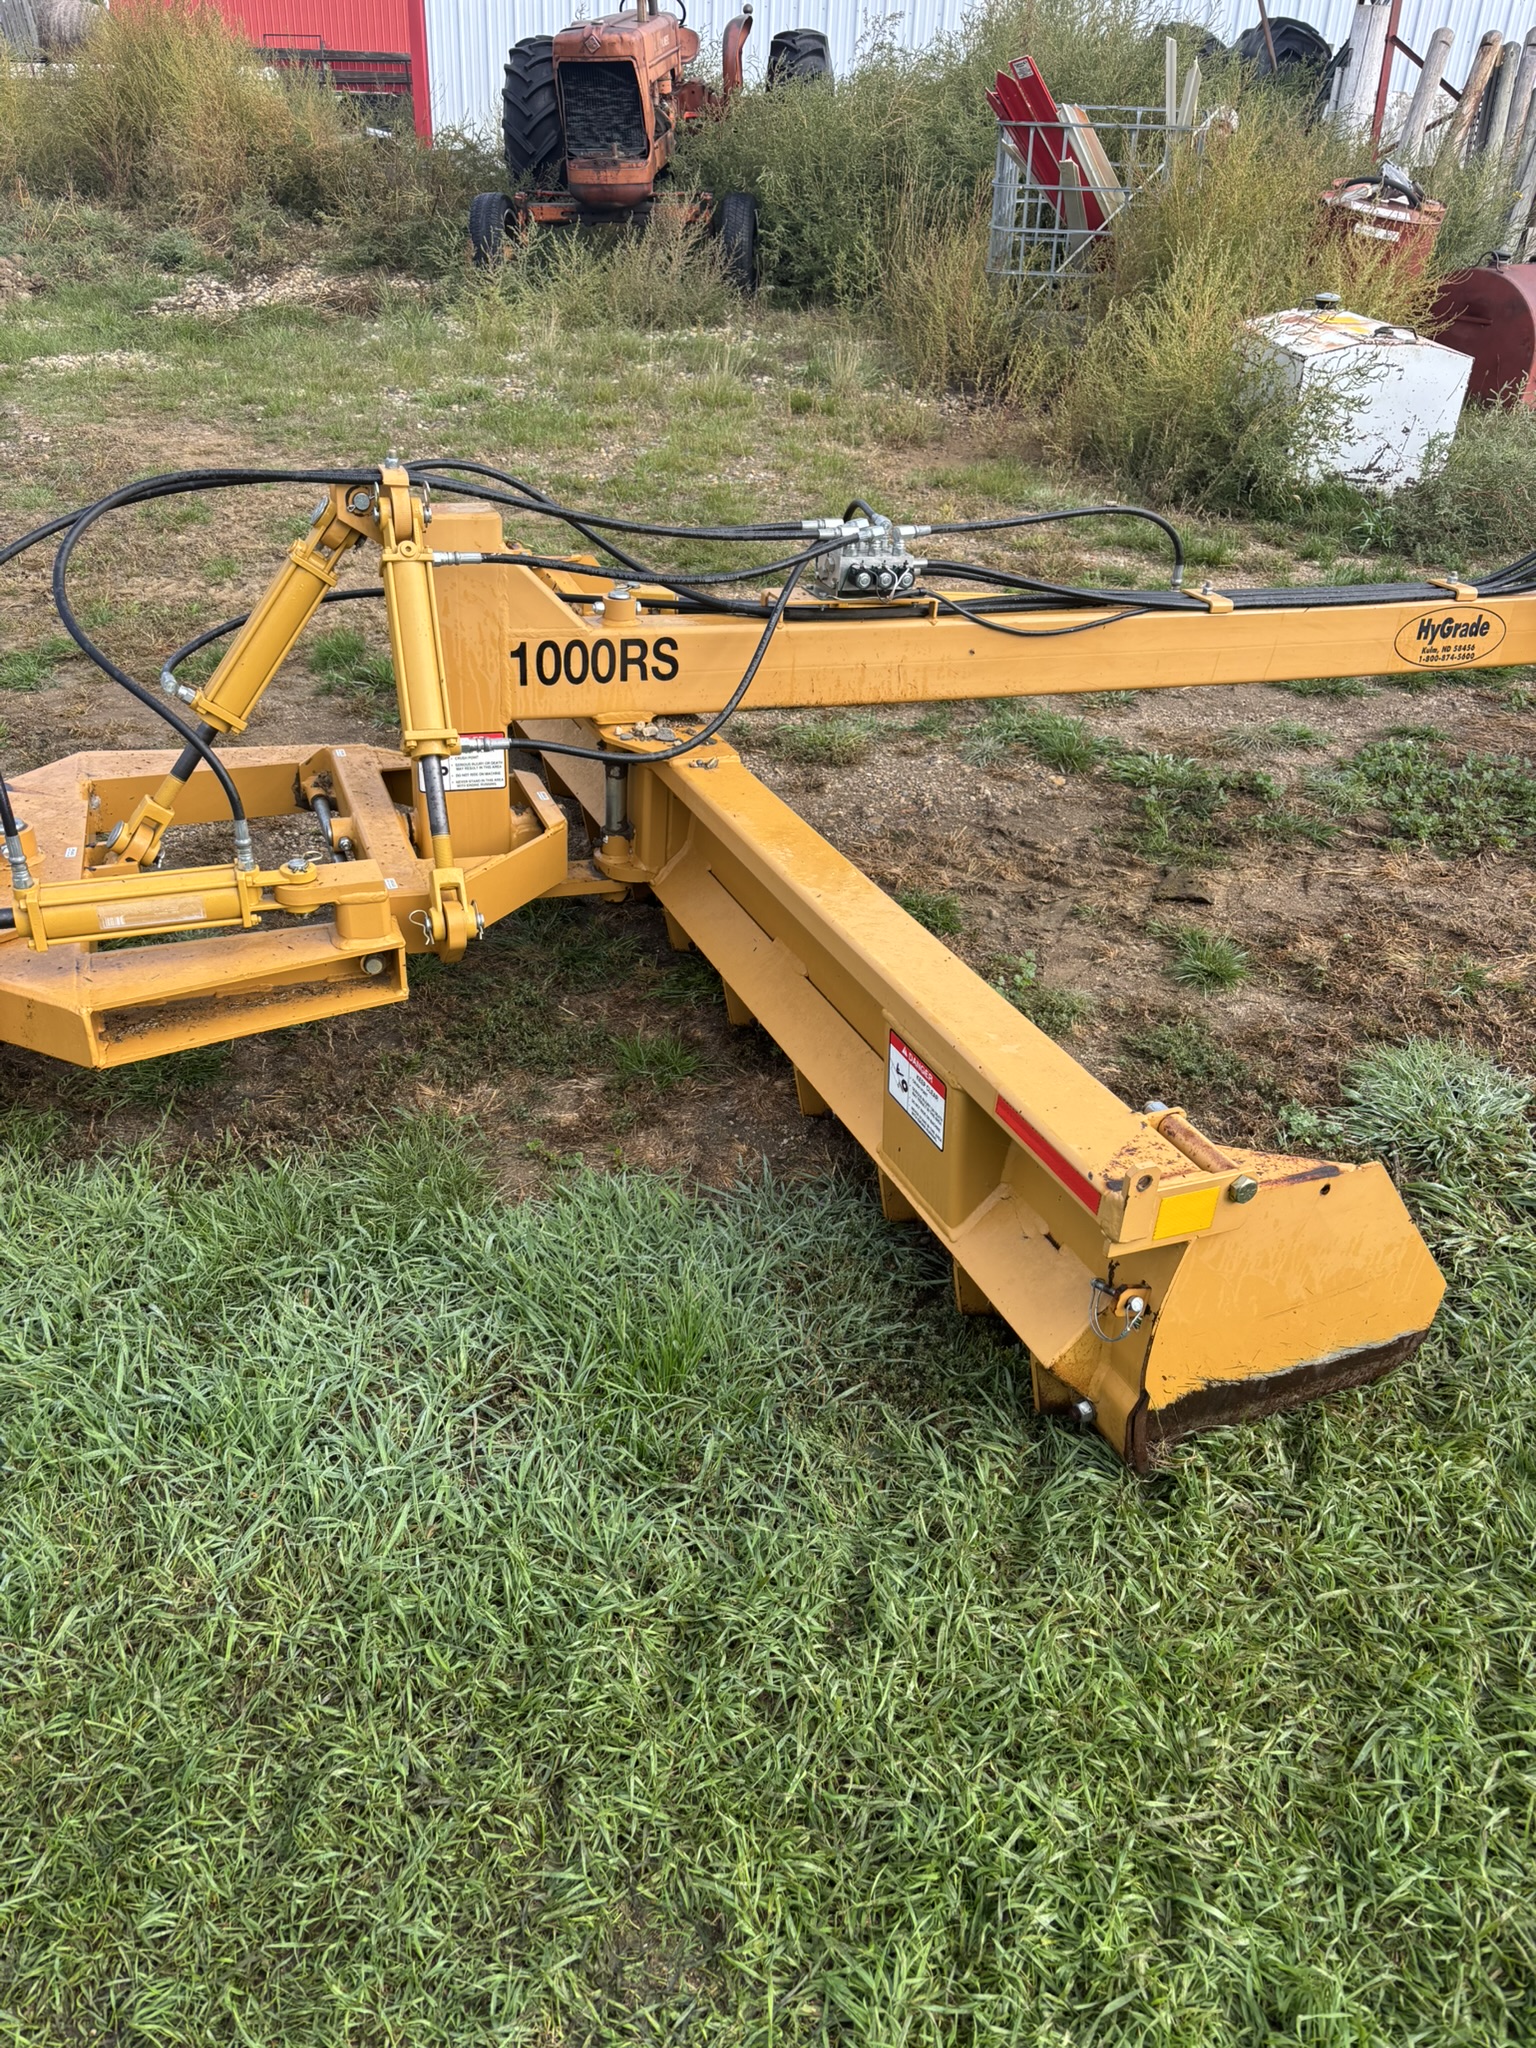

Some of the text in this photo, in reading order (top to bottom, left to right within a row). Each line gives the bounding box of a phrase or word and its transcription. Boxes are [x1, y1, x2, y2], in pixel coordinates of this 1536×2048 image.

[1416, 614, 1490, 646] HyGrade
[510, 636, 679, 687] 1000RS
[1441, 645, 1452, 653] ND
[907, 1053, 934, 1084] DANGER
